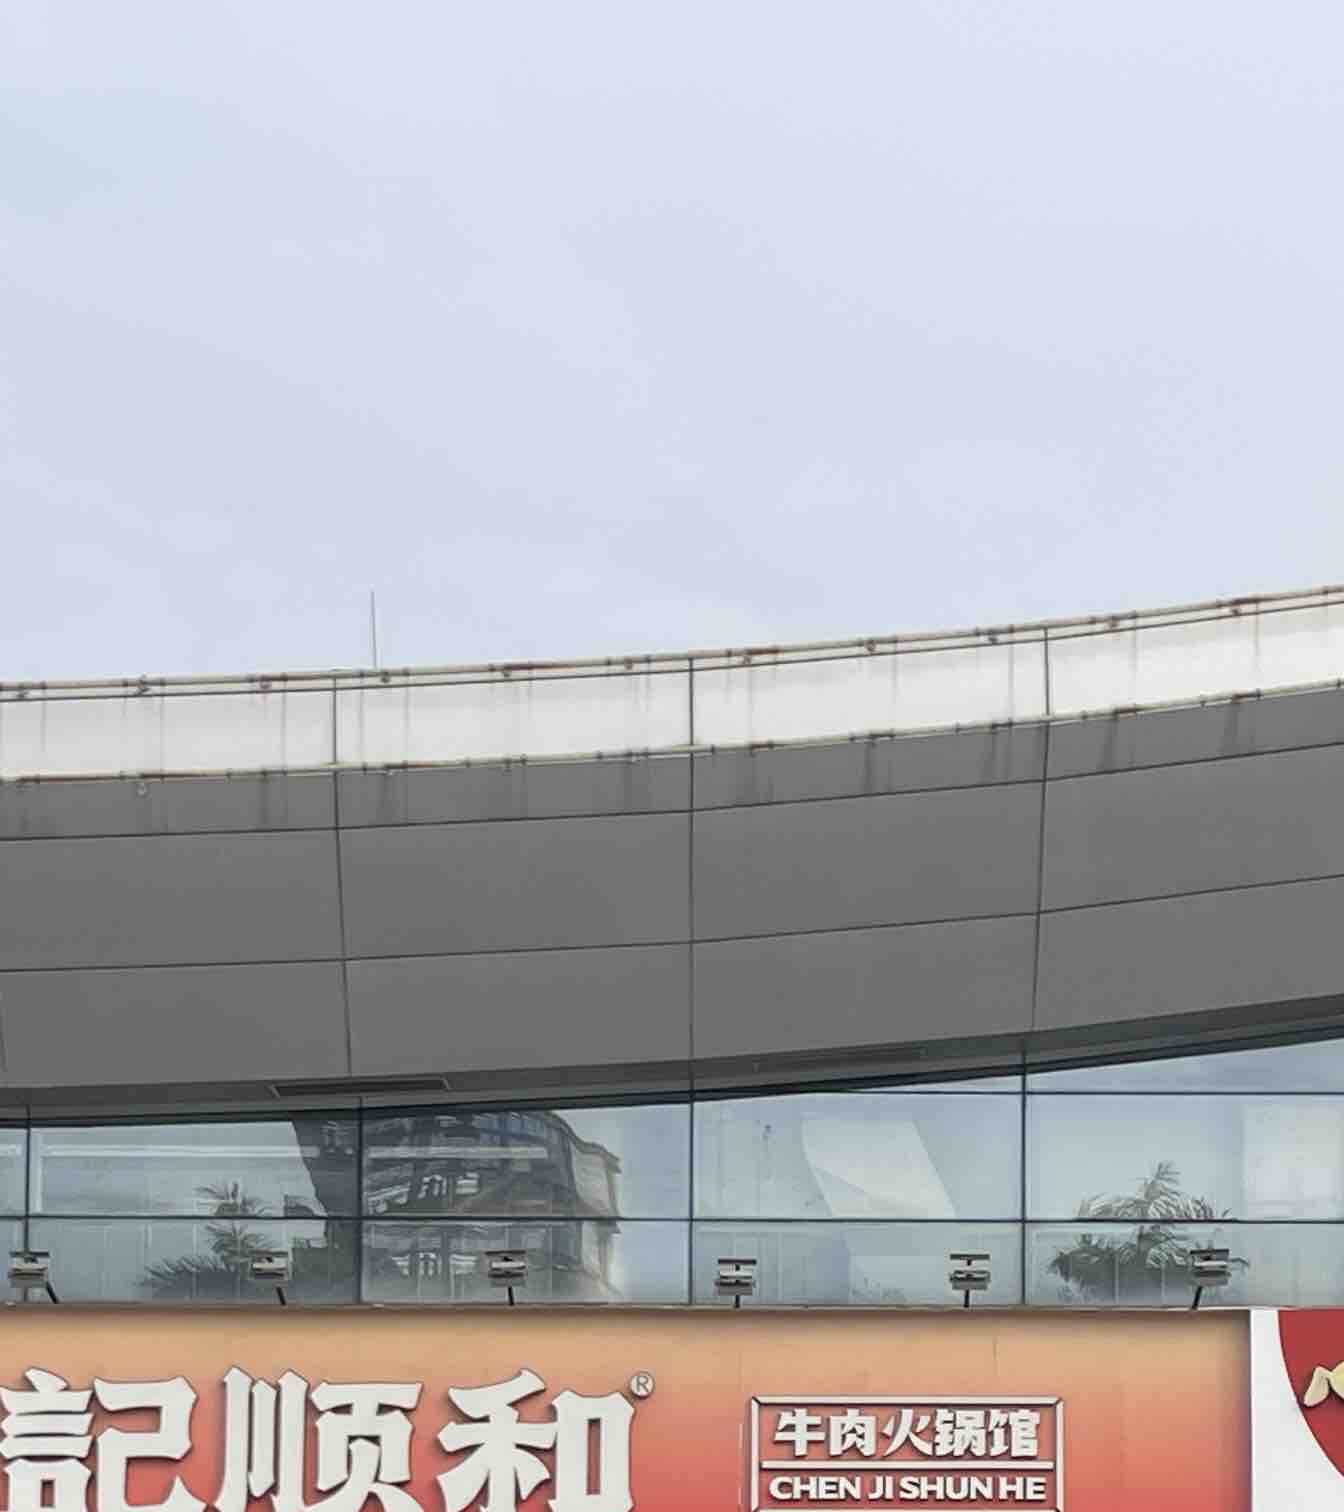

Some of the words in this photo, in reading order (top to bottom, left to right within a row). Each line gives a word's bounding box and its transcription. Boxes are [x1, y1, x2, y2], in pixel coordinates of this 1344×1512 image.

[773, 1408, 1042, 1458] 牛肉火锅馆
[769, 1476, 863, 1501] CHEN
[867, 1477, 894, 1501] JI
[898, 1477, 994, 1502] SHUN
[998, 1478, 1047, 1502] HE
